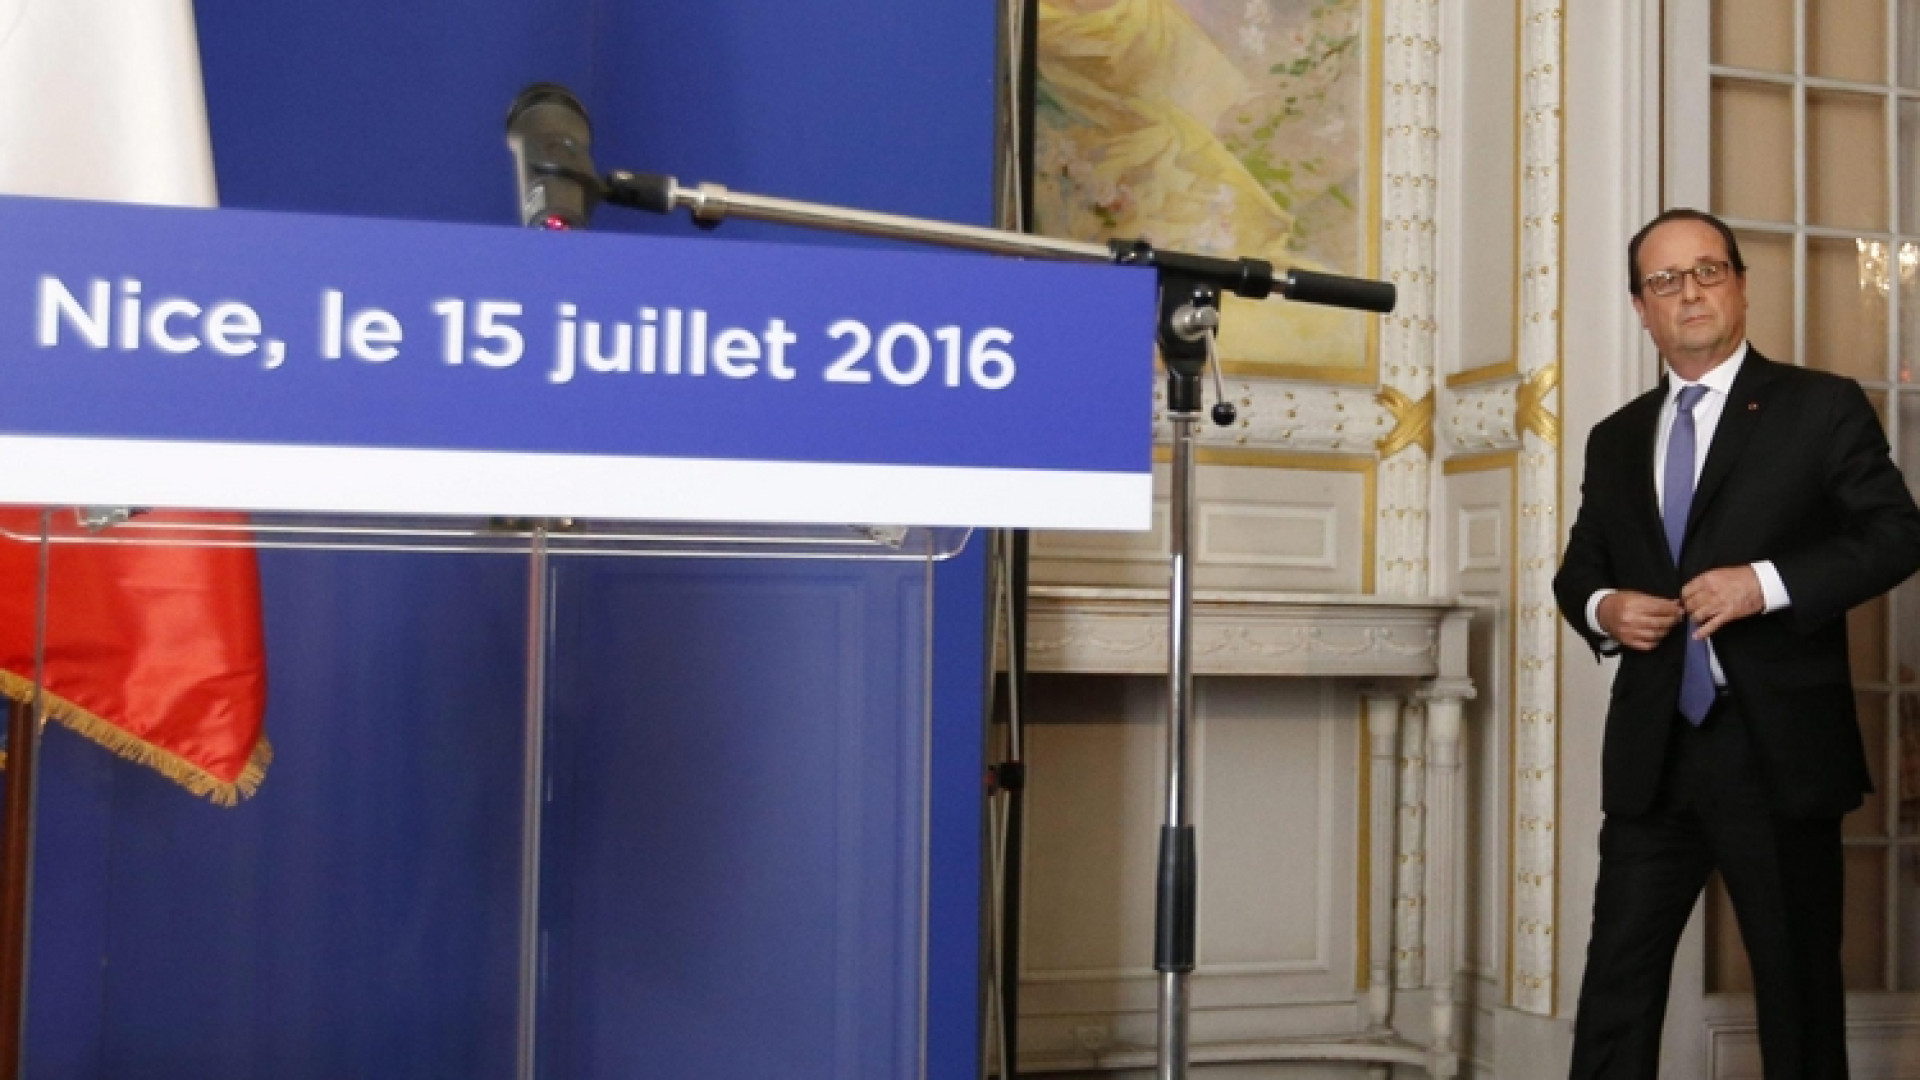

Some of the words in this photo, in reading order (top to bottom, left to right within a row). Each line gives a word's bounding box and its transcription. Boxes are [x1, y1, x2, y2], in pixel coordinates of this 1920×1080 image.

[37, 276, 287, 369] Nice,
[321, 289, 404, 362] le
[432, 299, 526, 368] 15
[549, 302, 797, 385] juillet
[823, 320, 1016, 390] 2016
